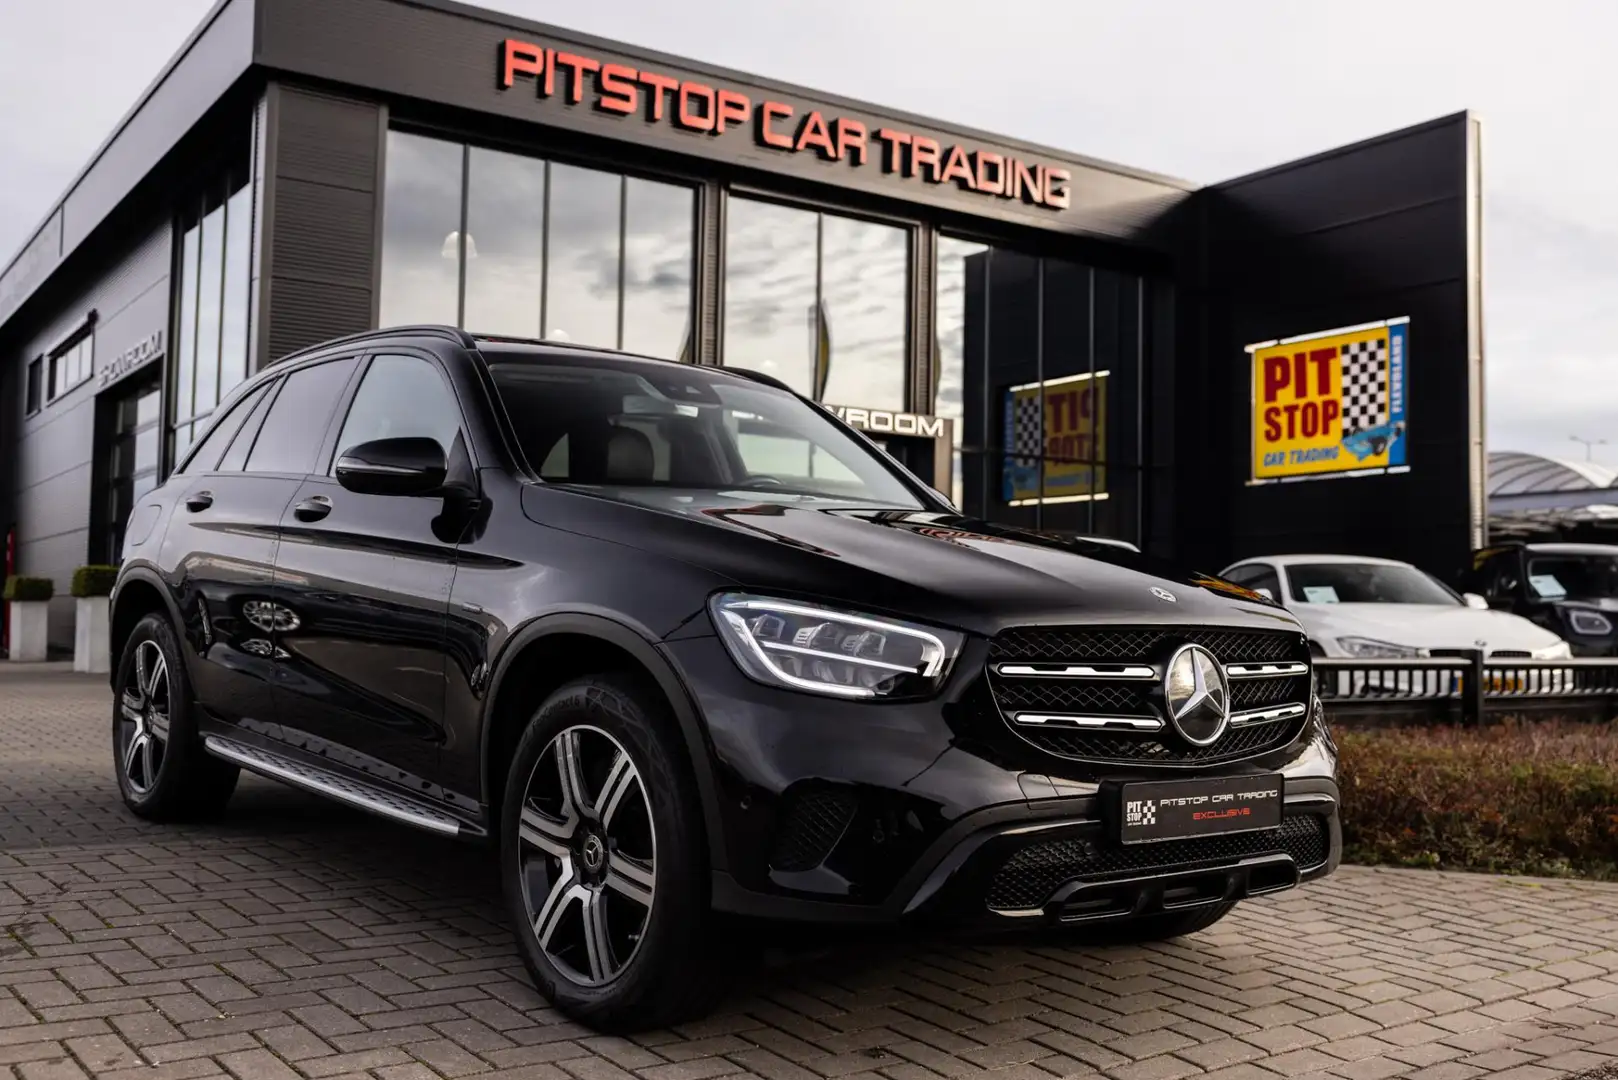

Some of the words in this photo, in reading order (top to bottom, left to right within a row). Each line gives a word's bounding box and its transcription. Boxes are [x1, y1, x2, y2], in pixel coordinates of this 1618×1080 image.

[502, 38, 751, 136] PITSTOP
[760, 101, 867, 167] CAR
[880, 128, 1072, 210] TRADING
[1263, 347, 1338, 404] PIT
[1264, 399, 1339, 443] STOP
[1263, 450, 1286, 467] CAR
[1290, 446, 1339, 465] TRADING
[1126, 800, 1143, 813] PIT
[1160, 796, 1209, 808] PITSTOP
[1211, 793, 1234, 803] CAR
[1237, 789, 1278, 800] TRADING
[1126, 812, 1143, 822] STOP
[1192, 807, 1251, 821] EXCLUSIVE
